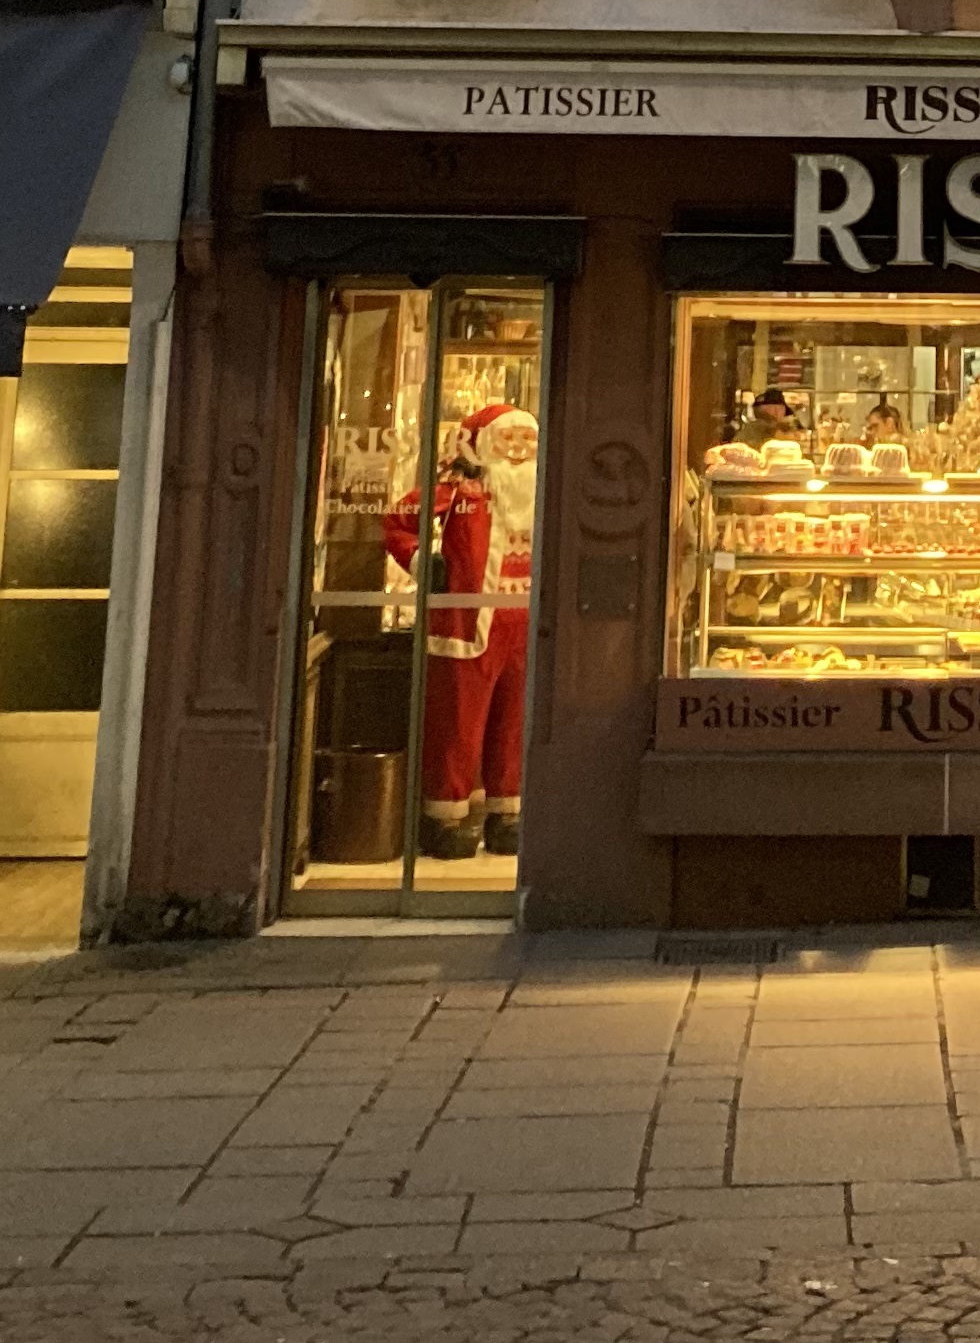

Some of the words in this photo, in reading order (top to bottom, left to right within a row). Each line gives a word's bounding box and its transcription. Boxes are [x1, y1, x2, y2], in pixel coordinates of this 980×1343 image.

[462, 84, 661, 118] PATISSIER
[455, 498, 477, 515] de
[678, 694, 842, 730] Pâtissier
